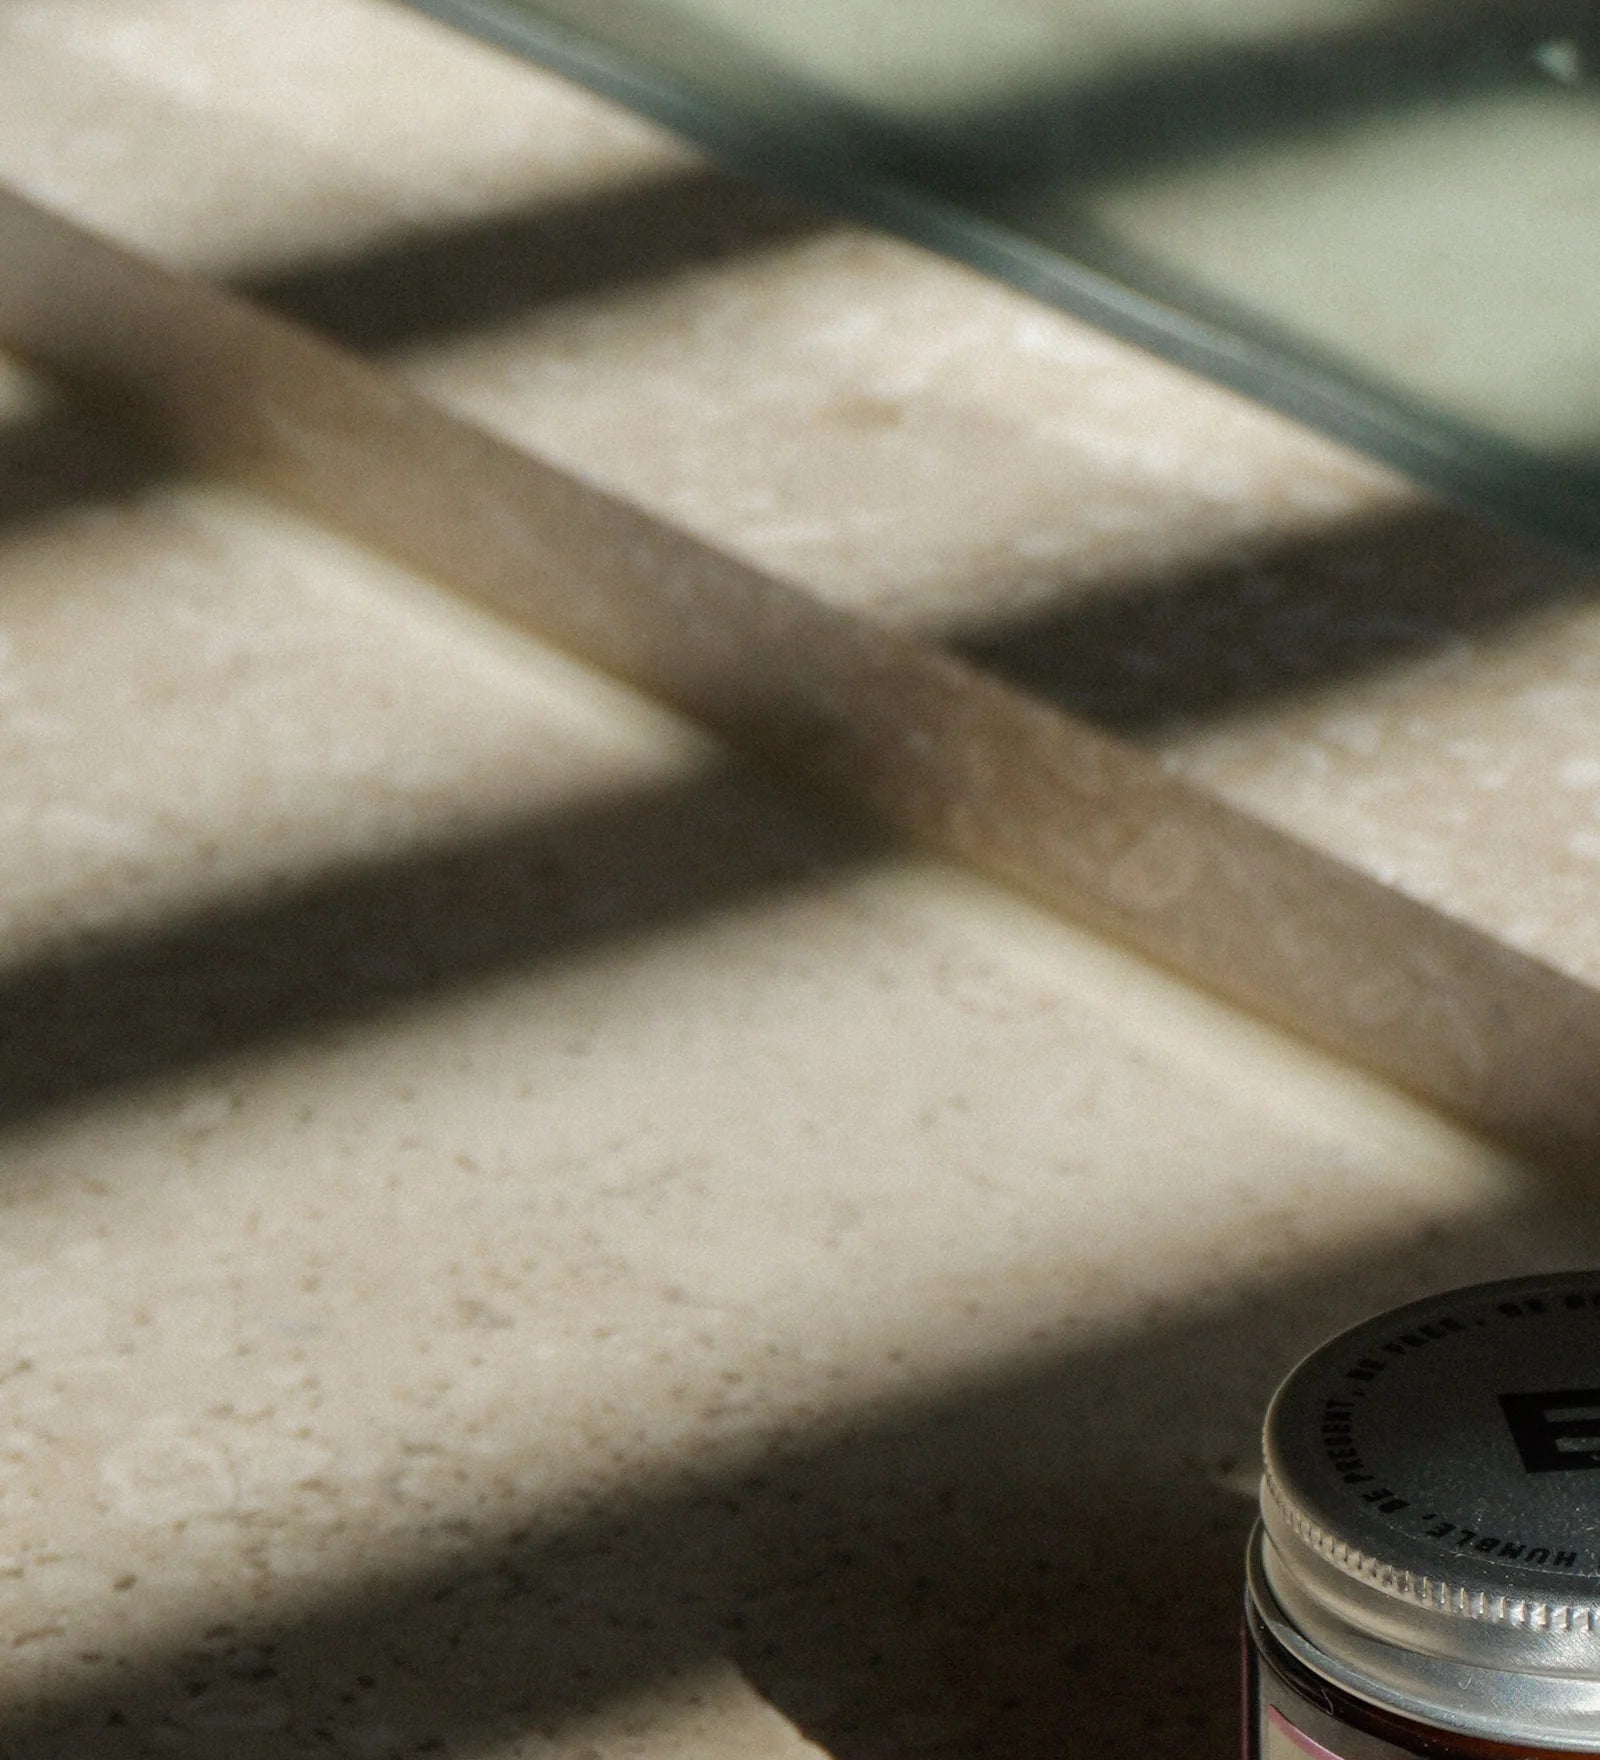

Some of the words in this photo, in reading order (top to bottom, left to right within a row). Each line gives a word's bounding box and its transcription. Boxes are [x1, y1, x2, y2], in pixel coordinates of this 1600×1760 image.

[1498, 1298, 1545, 1318] BE
[1346, 1358, 1387, 1382] BE
[1361, 1487, 1411, 1514] BE
[1422, 1513, 1578, 1568] HUMBLE,
